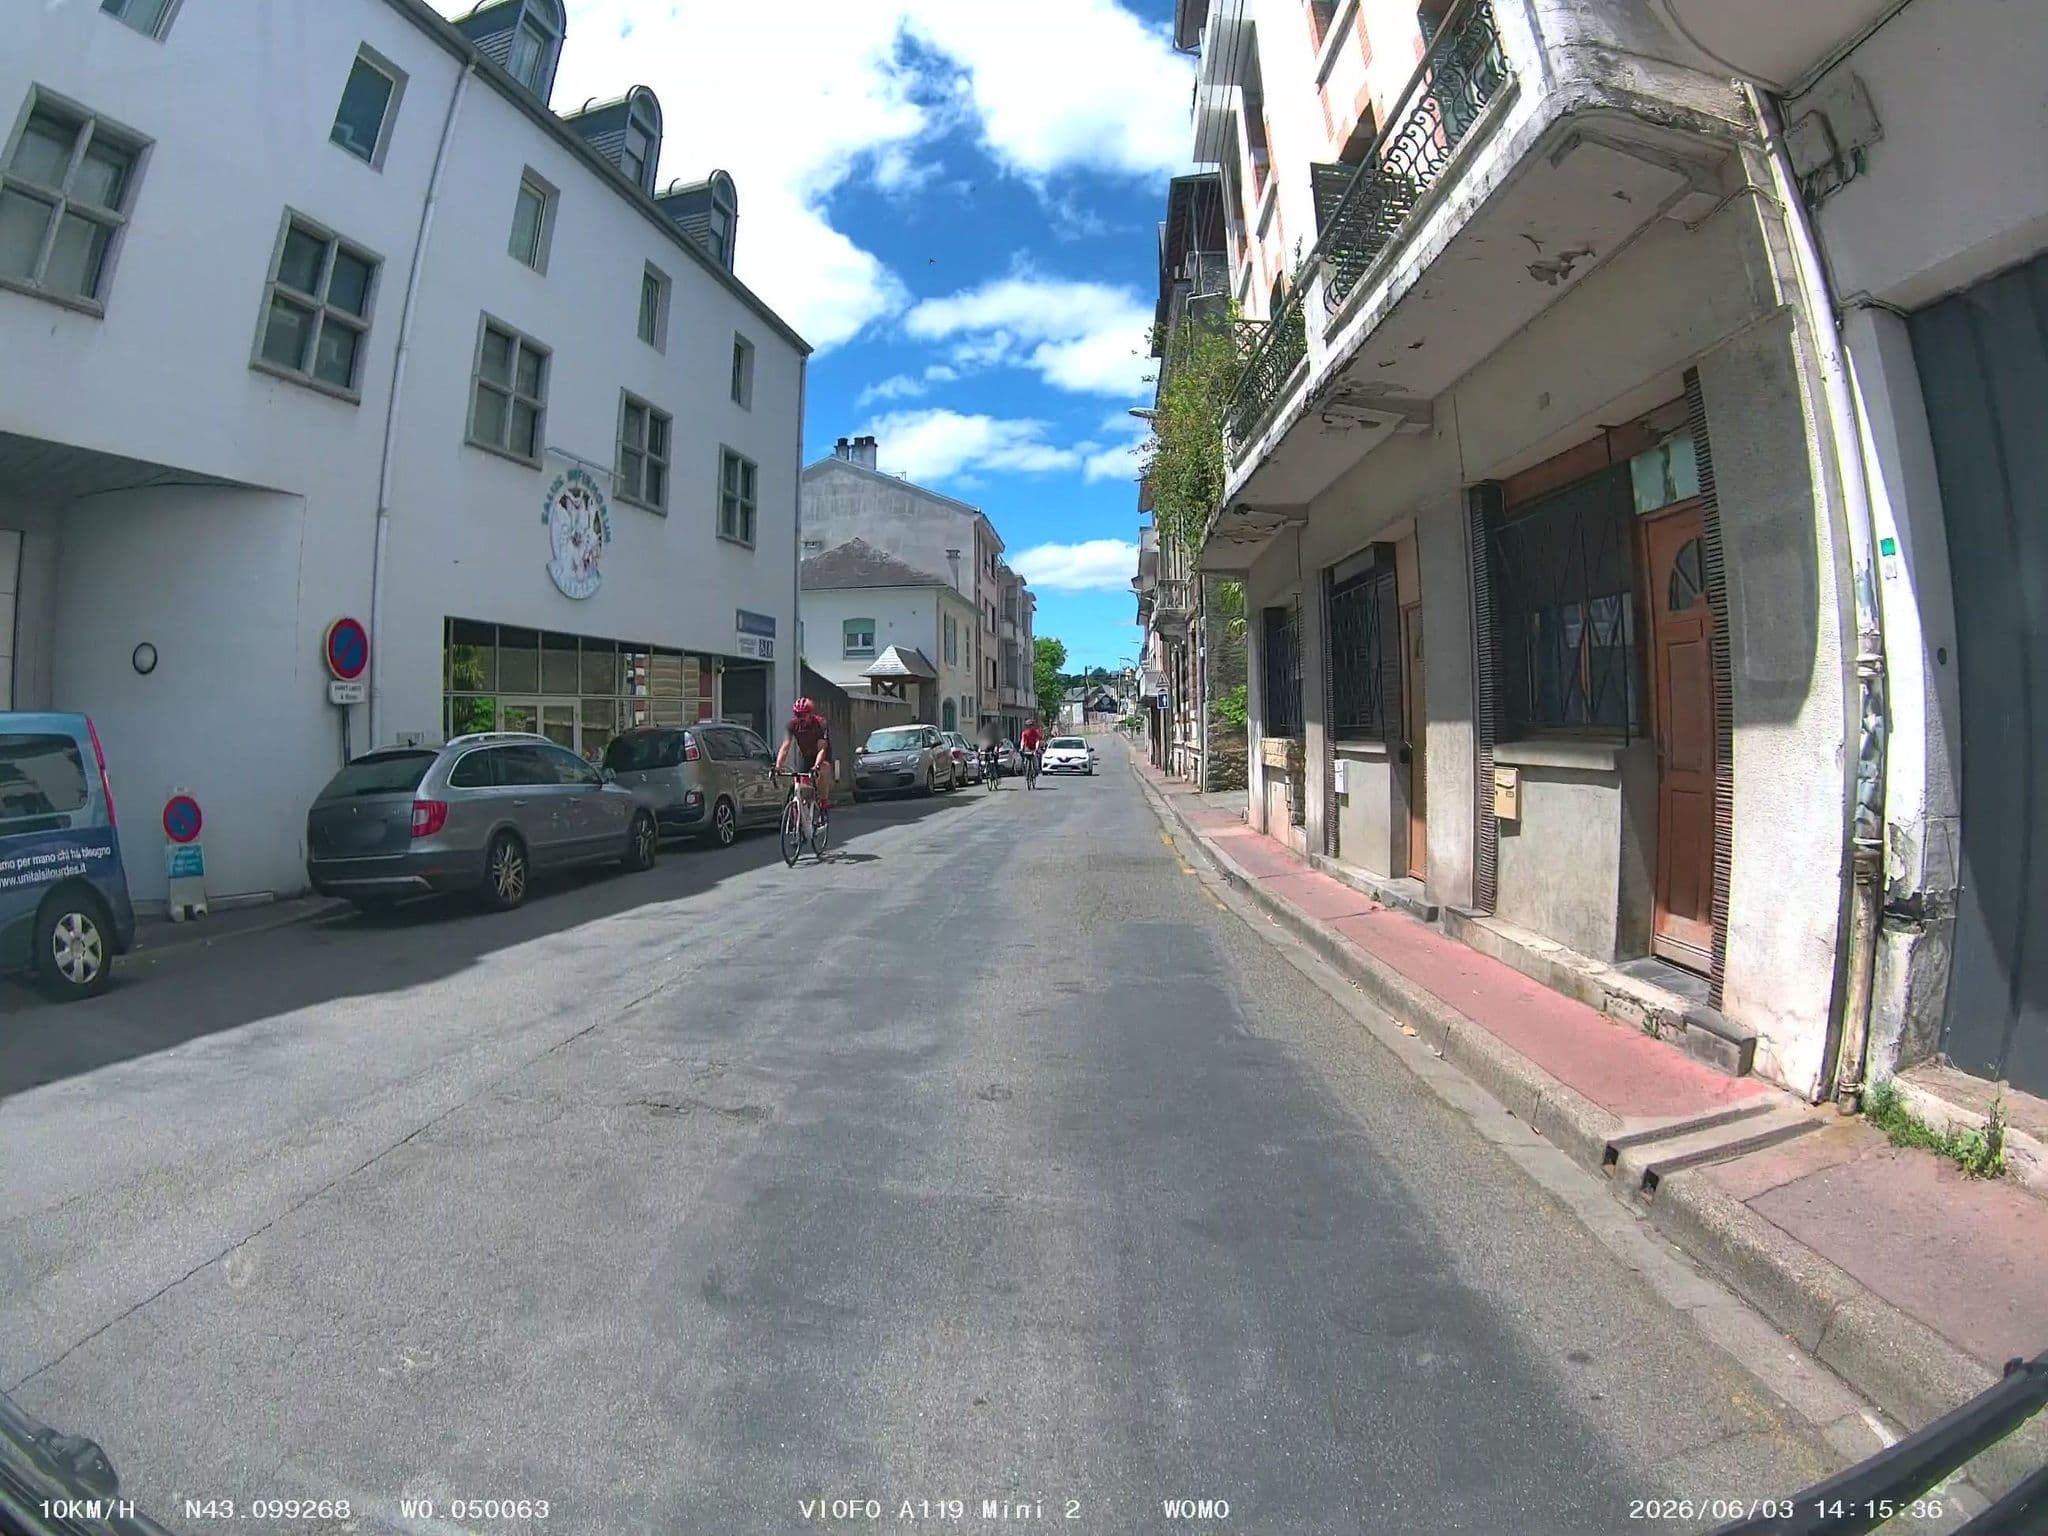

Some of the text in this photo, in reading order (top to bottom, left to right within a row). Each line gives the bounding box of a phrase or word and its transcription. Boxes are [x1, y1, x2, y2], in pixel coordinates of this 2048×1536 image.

[17, 857, 31, 871] per
[33, 853, 56, 865] mano
[57, 850, 70, 861] chi
[82, 846, 111, 859] bisogno
